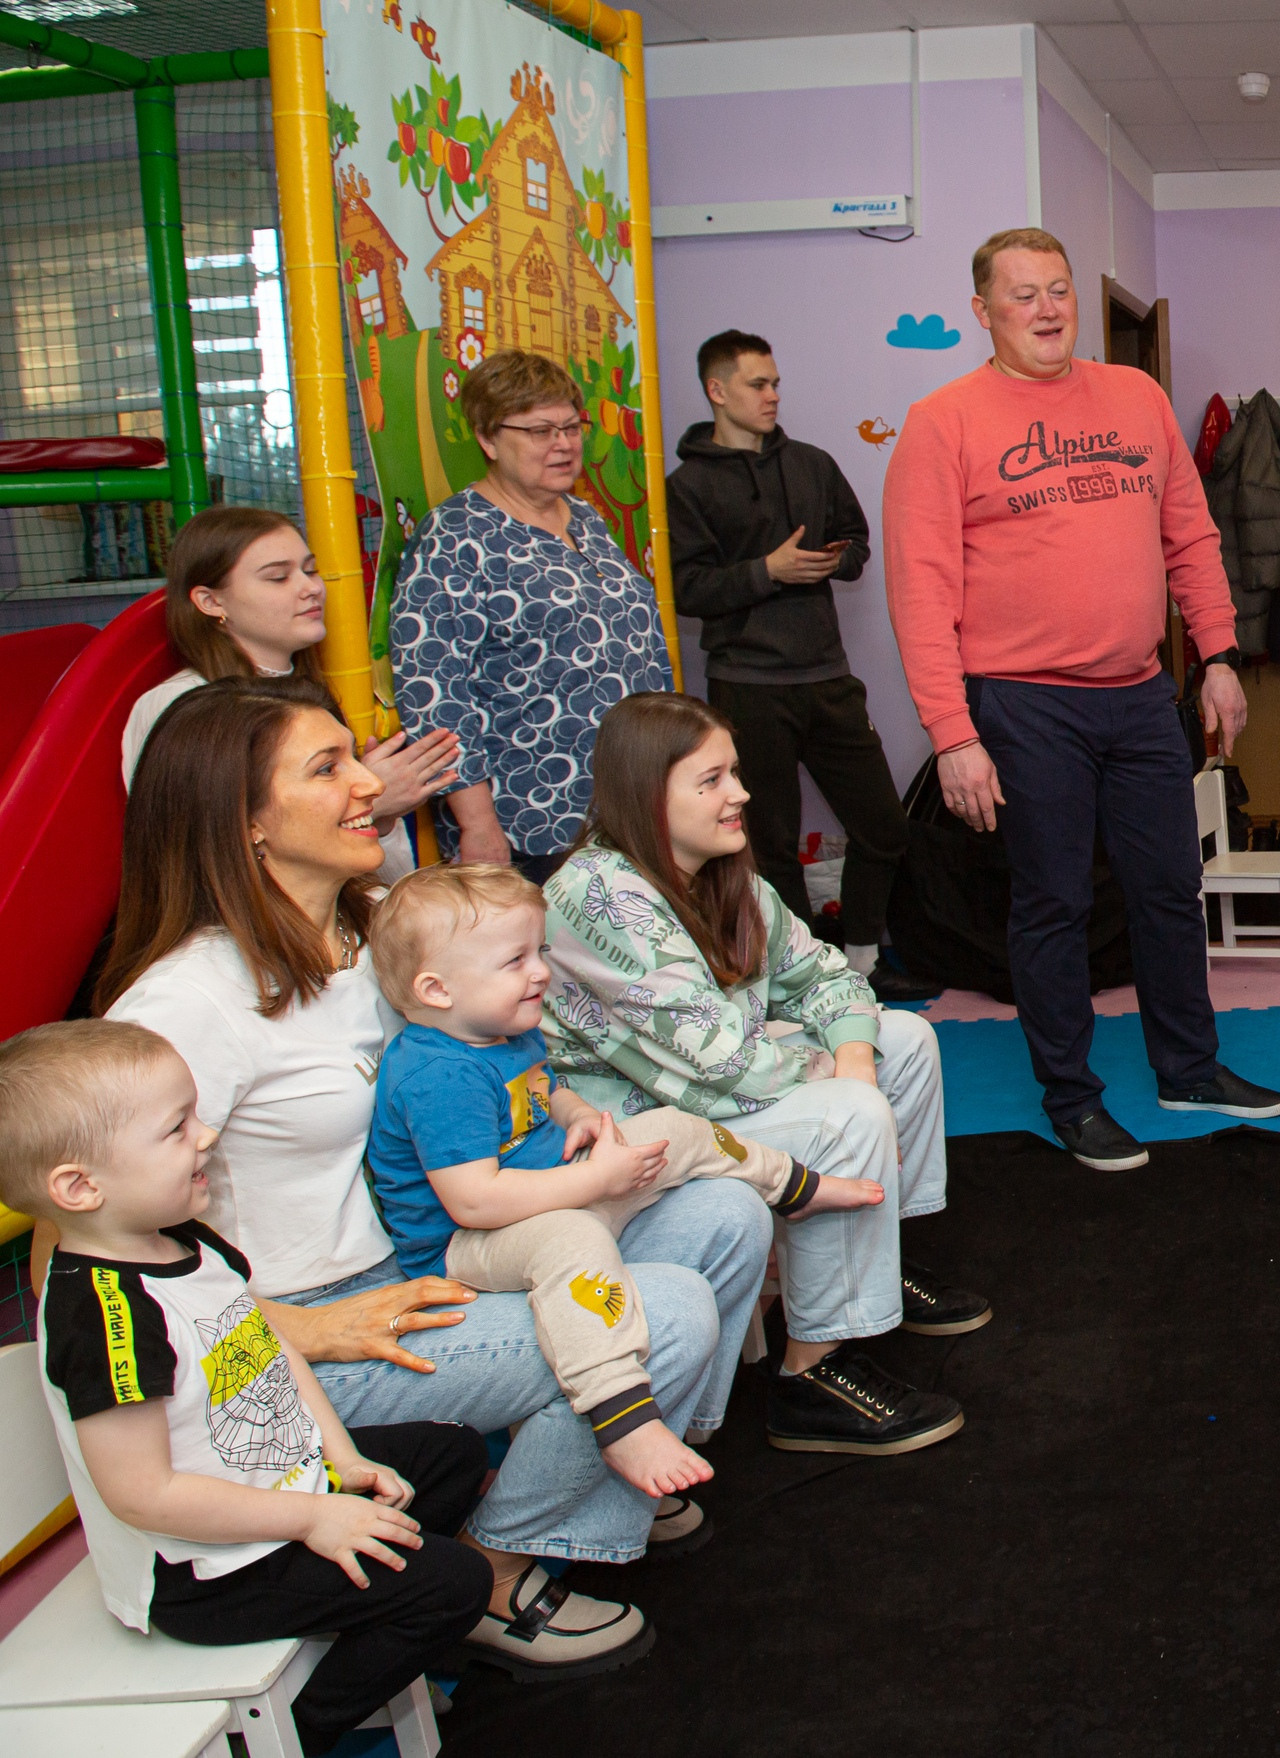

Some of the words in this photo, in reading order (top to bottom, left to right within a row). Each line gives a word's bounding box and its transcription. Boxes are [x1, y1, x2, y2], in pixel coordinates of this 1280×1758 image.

[999, 421, 1122, 470] Alpine
[1118, 445, 1154, 456] VALLEY
[1092, 463, 1110, 472] EST.
[1007, 486, 1067, 514] SWISS
[1070, 475, 1116, 500] 1996
[1120, 474, 1154, 493] ALPS
[554, 890, 586, 931] LATE
[585, 923, 608, 951] TO
[607, 944, 639, 976] DIE
[108, 1302, 126, 1342] HAVE
